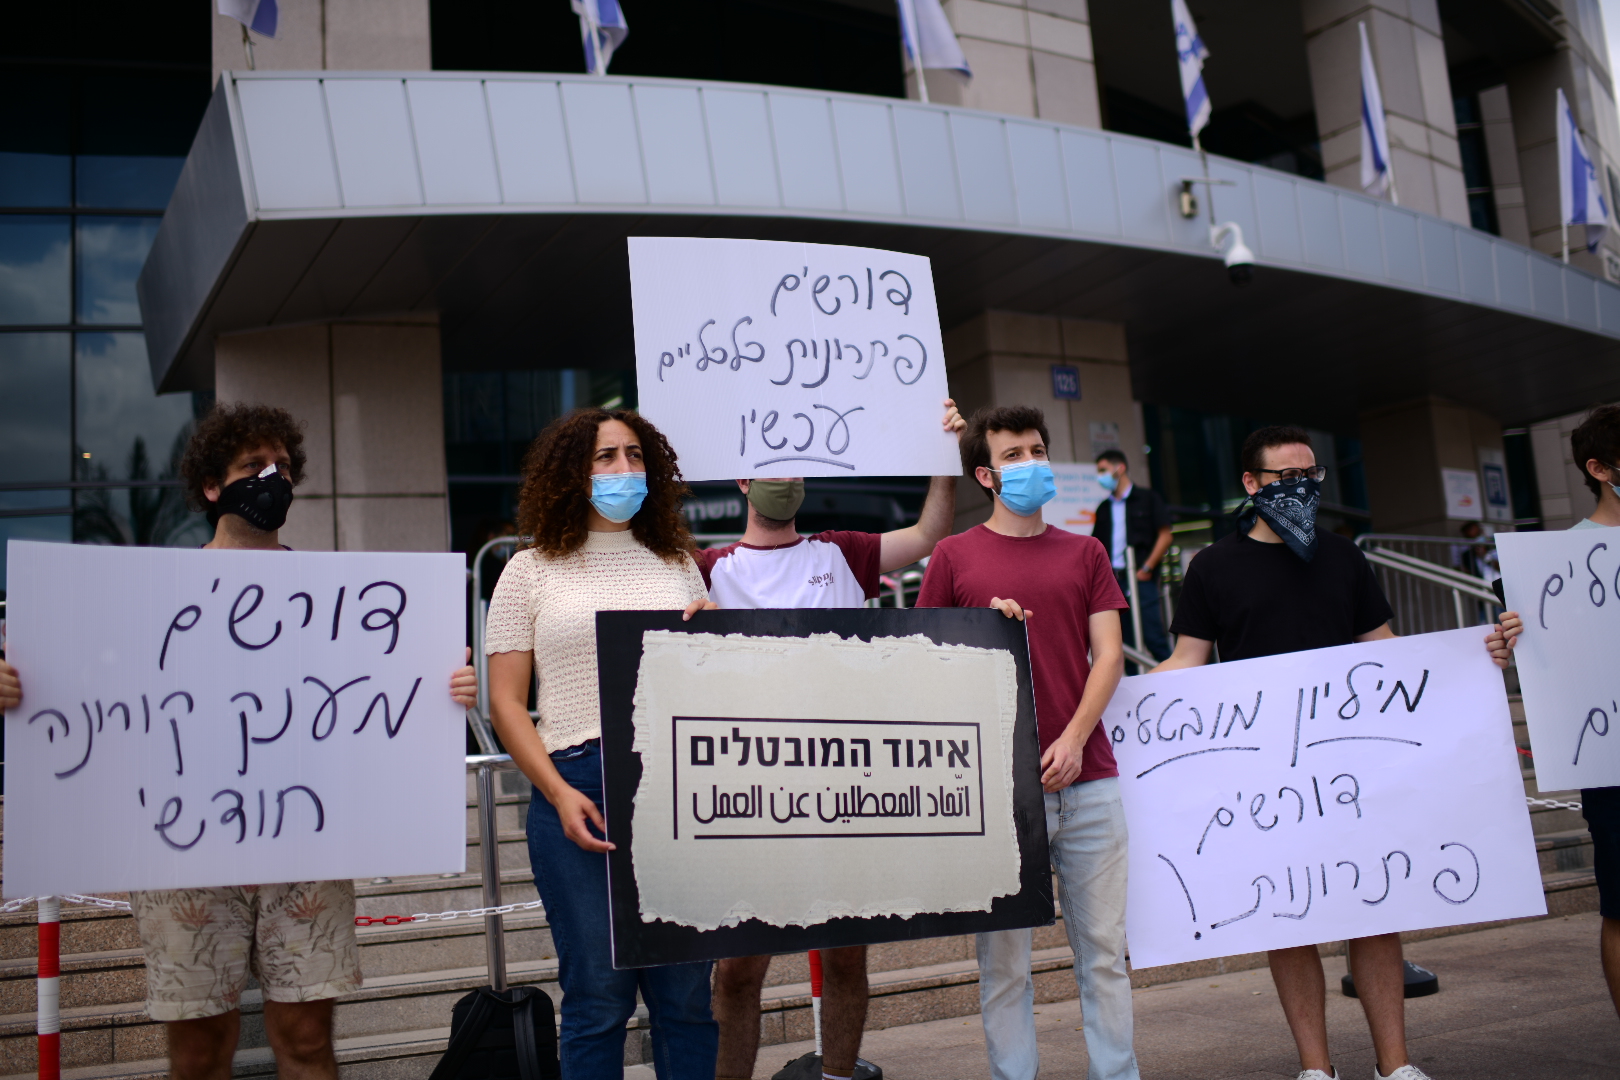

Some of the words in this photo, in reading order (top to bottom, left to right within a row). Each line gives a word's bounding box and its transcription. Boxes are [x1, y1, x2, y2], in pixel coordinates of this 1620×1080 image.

[769, 265, 913, 318] דורשים
[657, 315, 766, 383] כלכליים
[770, 333, 928, 389] פתרונות
[739, 403, 866, 457] עכשיו
[1538, 541, 1620, 630] לים
[158, 577, 408, 672] דורשים
[28, 690, 195, 781] קורונה
[229, 676, 423, 779] מענק
[690, 726, 872, 768] המובטלים
[1111, 690, 1263, 751] מובטלים
[1289, 661, 1430, 769] מיליון
[883, 738, 972, 769] איגוד
[138, 784, 326, 853] חודשי
[692, 784, 763, 824] العمل
[769, 785, 811, 824] عن
[1196, 773, 1362, 856] דורשים
